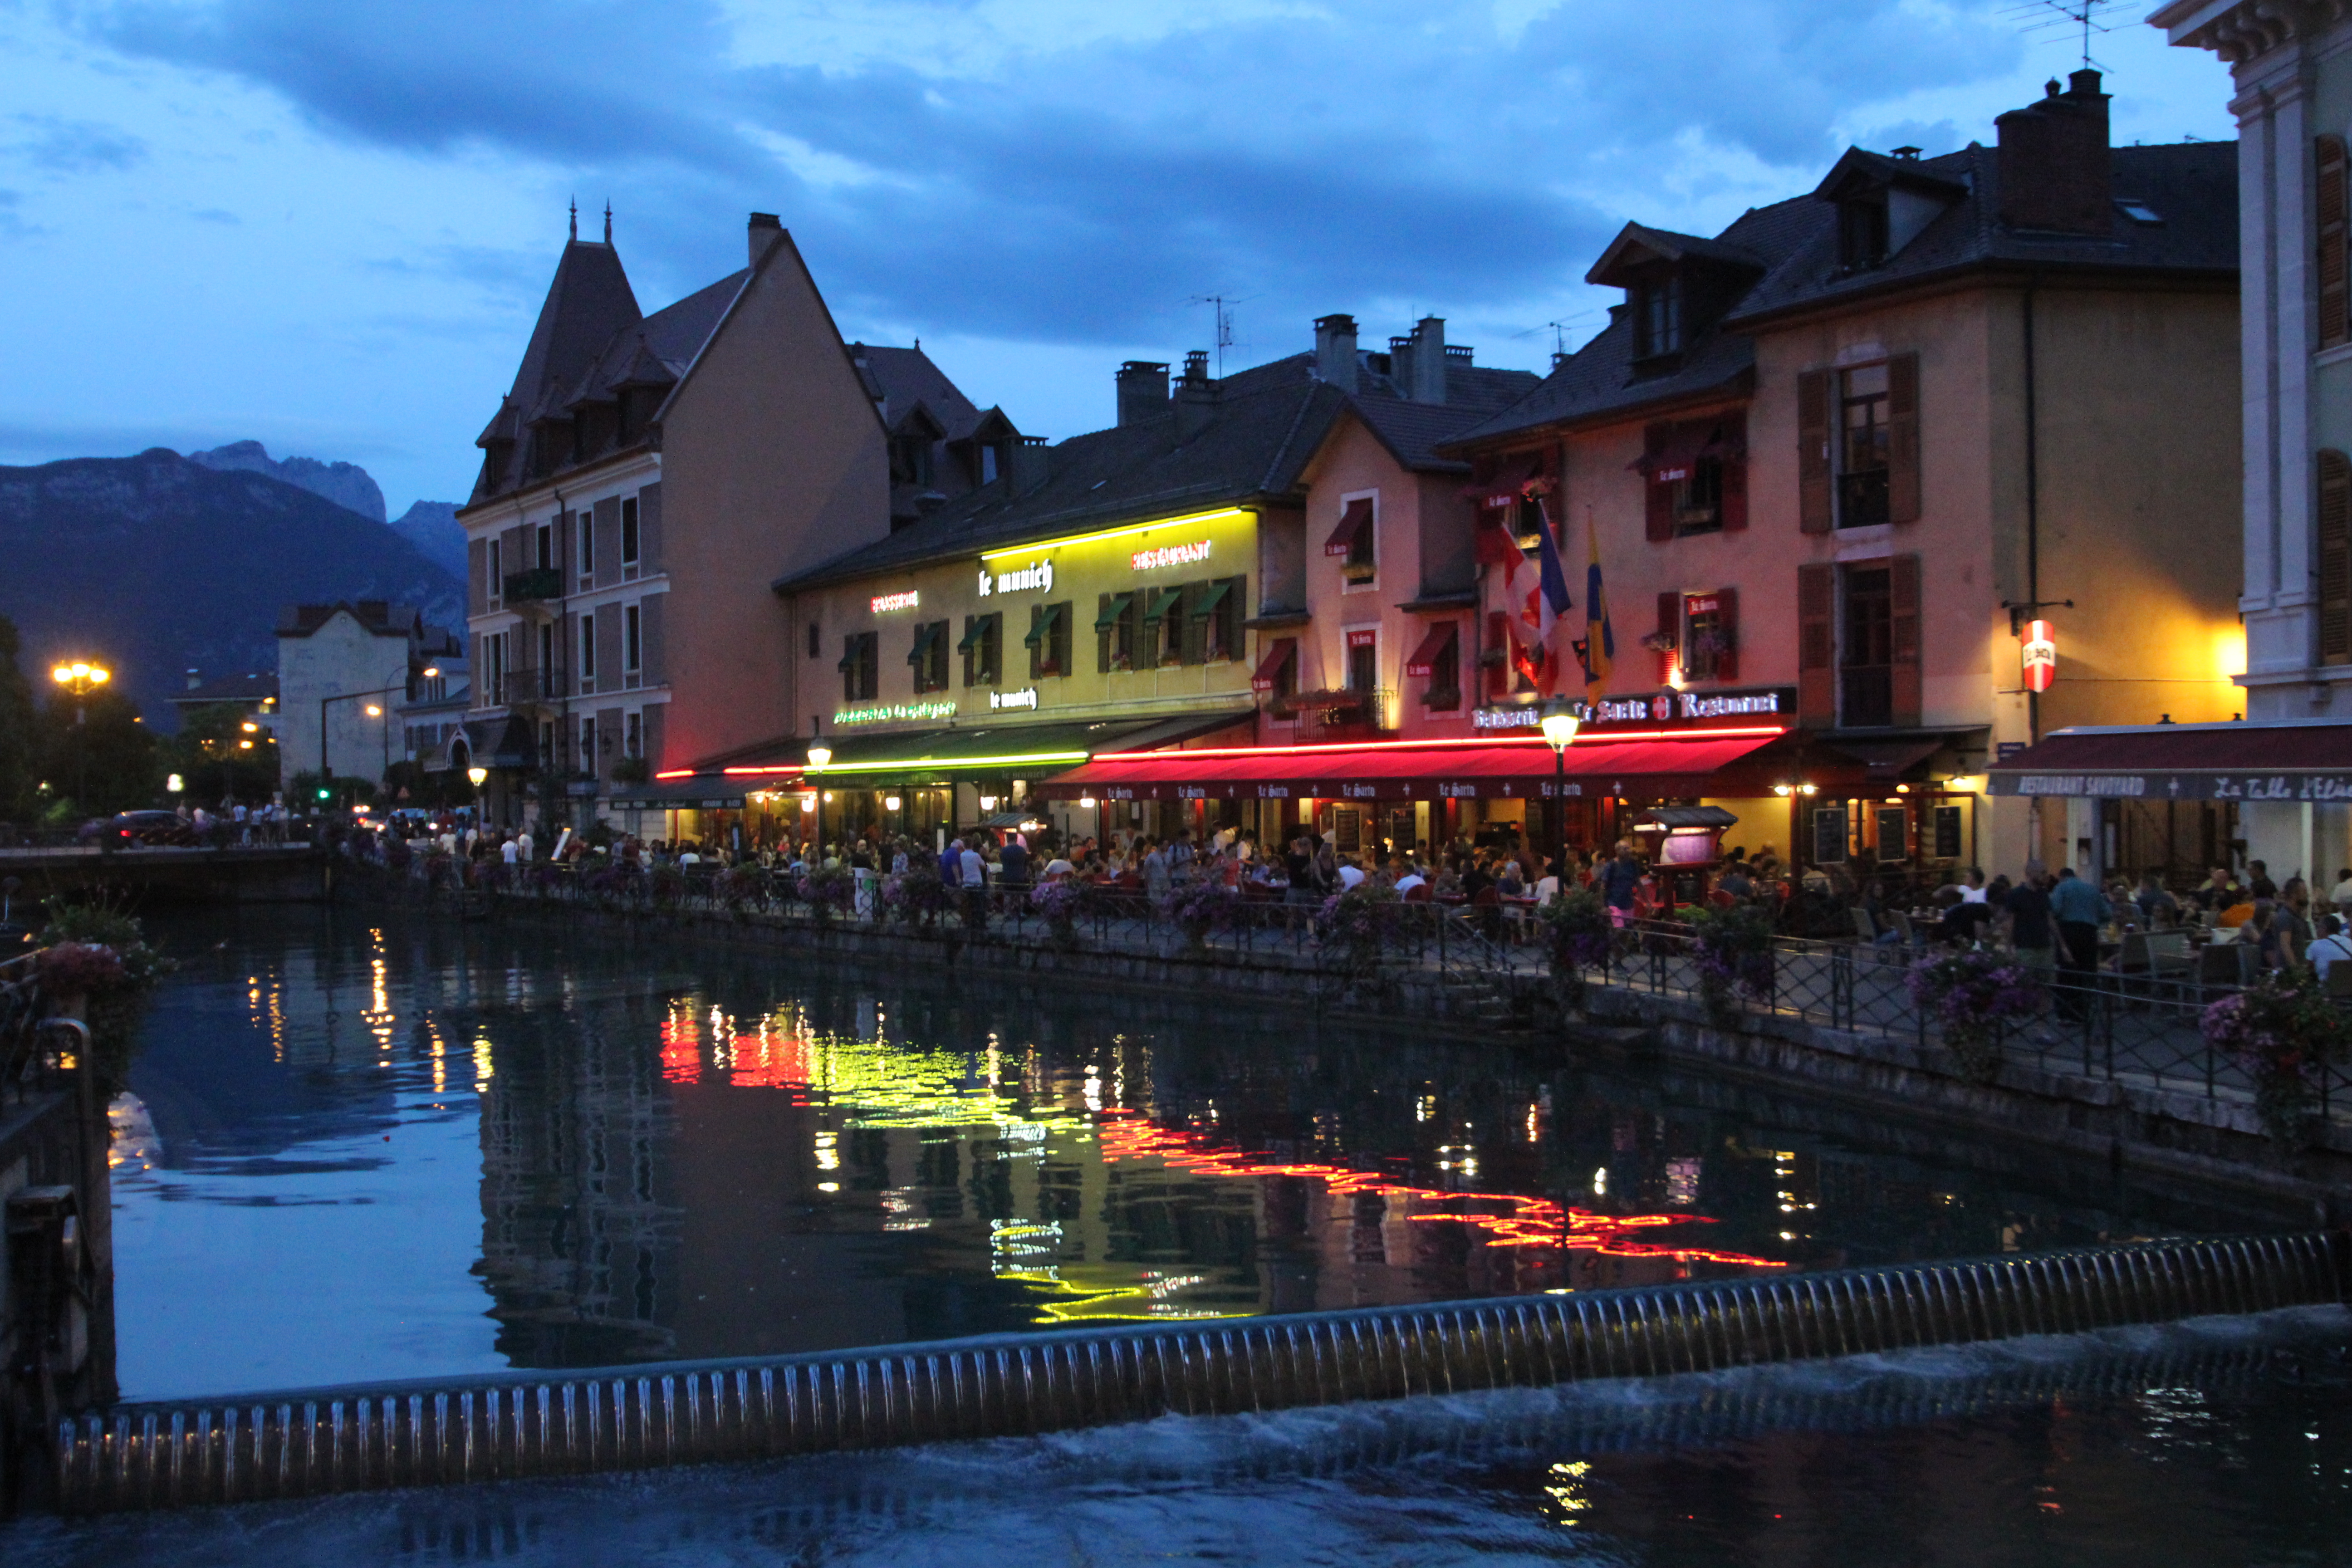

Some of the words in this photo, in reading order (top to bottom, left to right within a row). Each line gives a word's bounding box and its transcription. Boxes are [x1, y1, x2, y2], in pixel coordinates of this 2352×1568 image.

[1131, 539, 1211, 570] RESTAURANT
[979, 570, 992, 597] le
[998, 559, 1052, 593] munich
[871, 590, 918, 613] BRASSERIE
[1001, 687, 1036, 710] munich
[1596, 699, 1647, 724] Sarto
[1677, 693, 1778, 718] Restaurant
[1258, 785, 1266, 797] Le
[1268, 784, 1288, 797] Sarto
[1342, 784, 1351, 797] Le
[1353, 783, 1375, 797] Sarto
[1439, 783, 1449, 796] Le
[1451, 782, 1475, 797] Sarto
[1540, 781, 1552, 796] Le
[2018, 776, 2084, 794] RESTAURANT
[2085, 776, 2145, 795] SAVOYARD
[2215, 777, 2242, 798] La
[2246, 777, 2291, 799] Table
